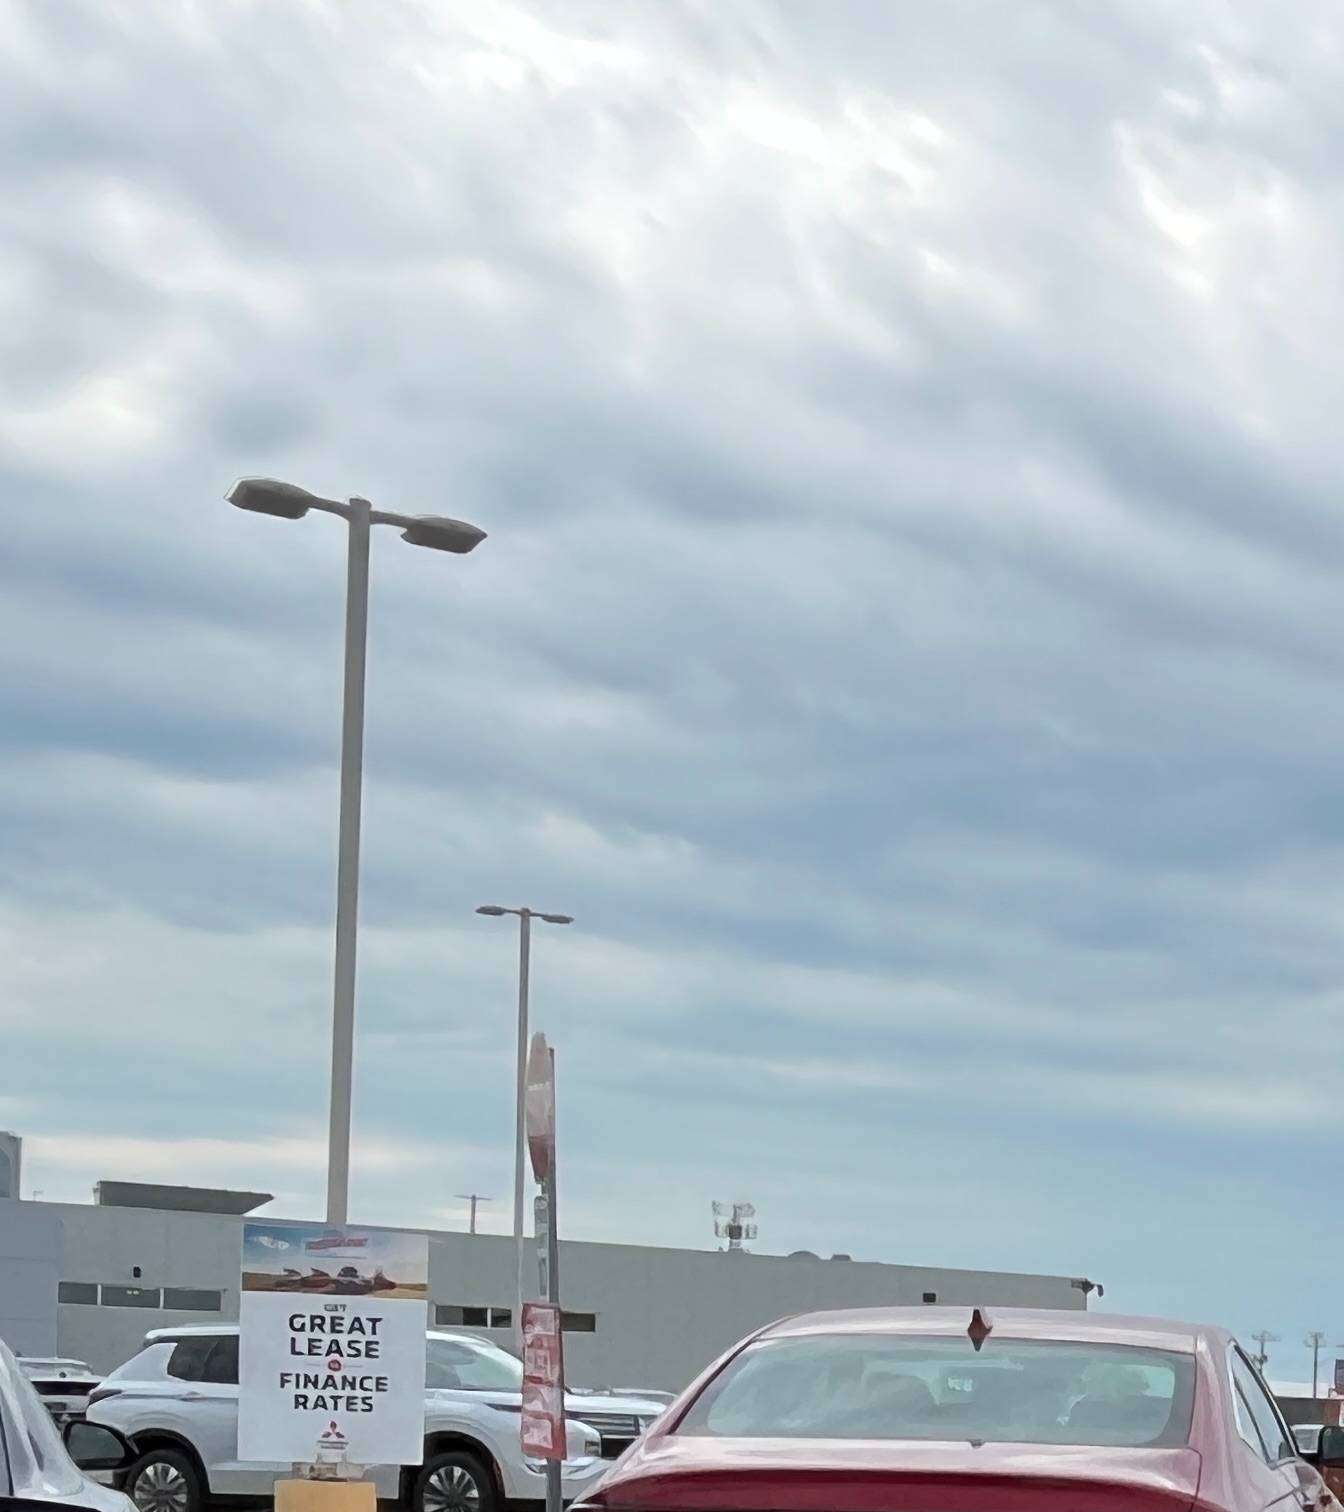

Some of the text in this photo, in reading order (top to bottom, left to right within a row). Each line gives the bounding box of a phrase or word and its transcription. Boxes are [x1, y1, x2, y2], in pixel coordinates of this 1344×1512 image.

[289, 1314, 383, 1335] GREAT
[290, 1337, 380, 1358] LEASE
[280, 1372, 388, 1393] FINANCE
[294, 1394, 373, 1413] RATES
